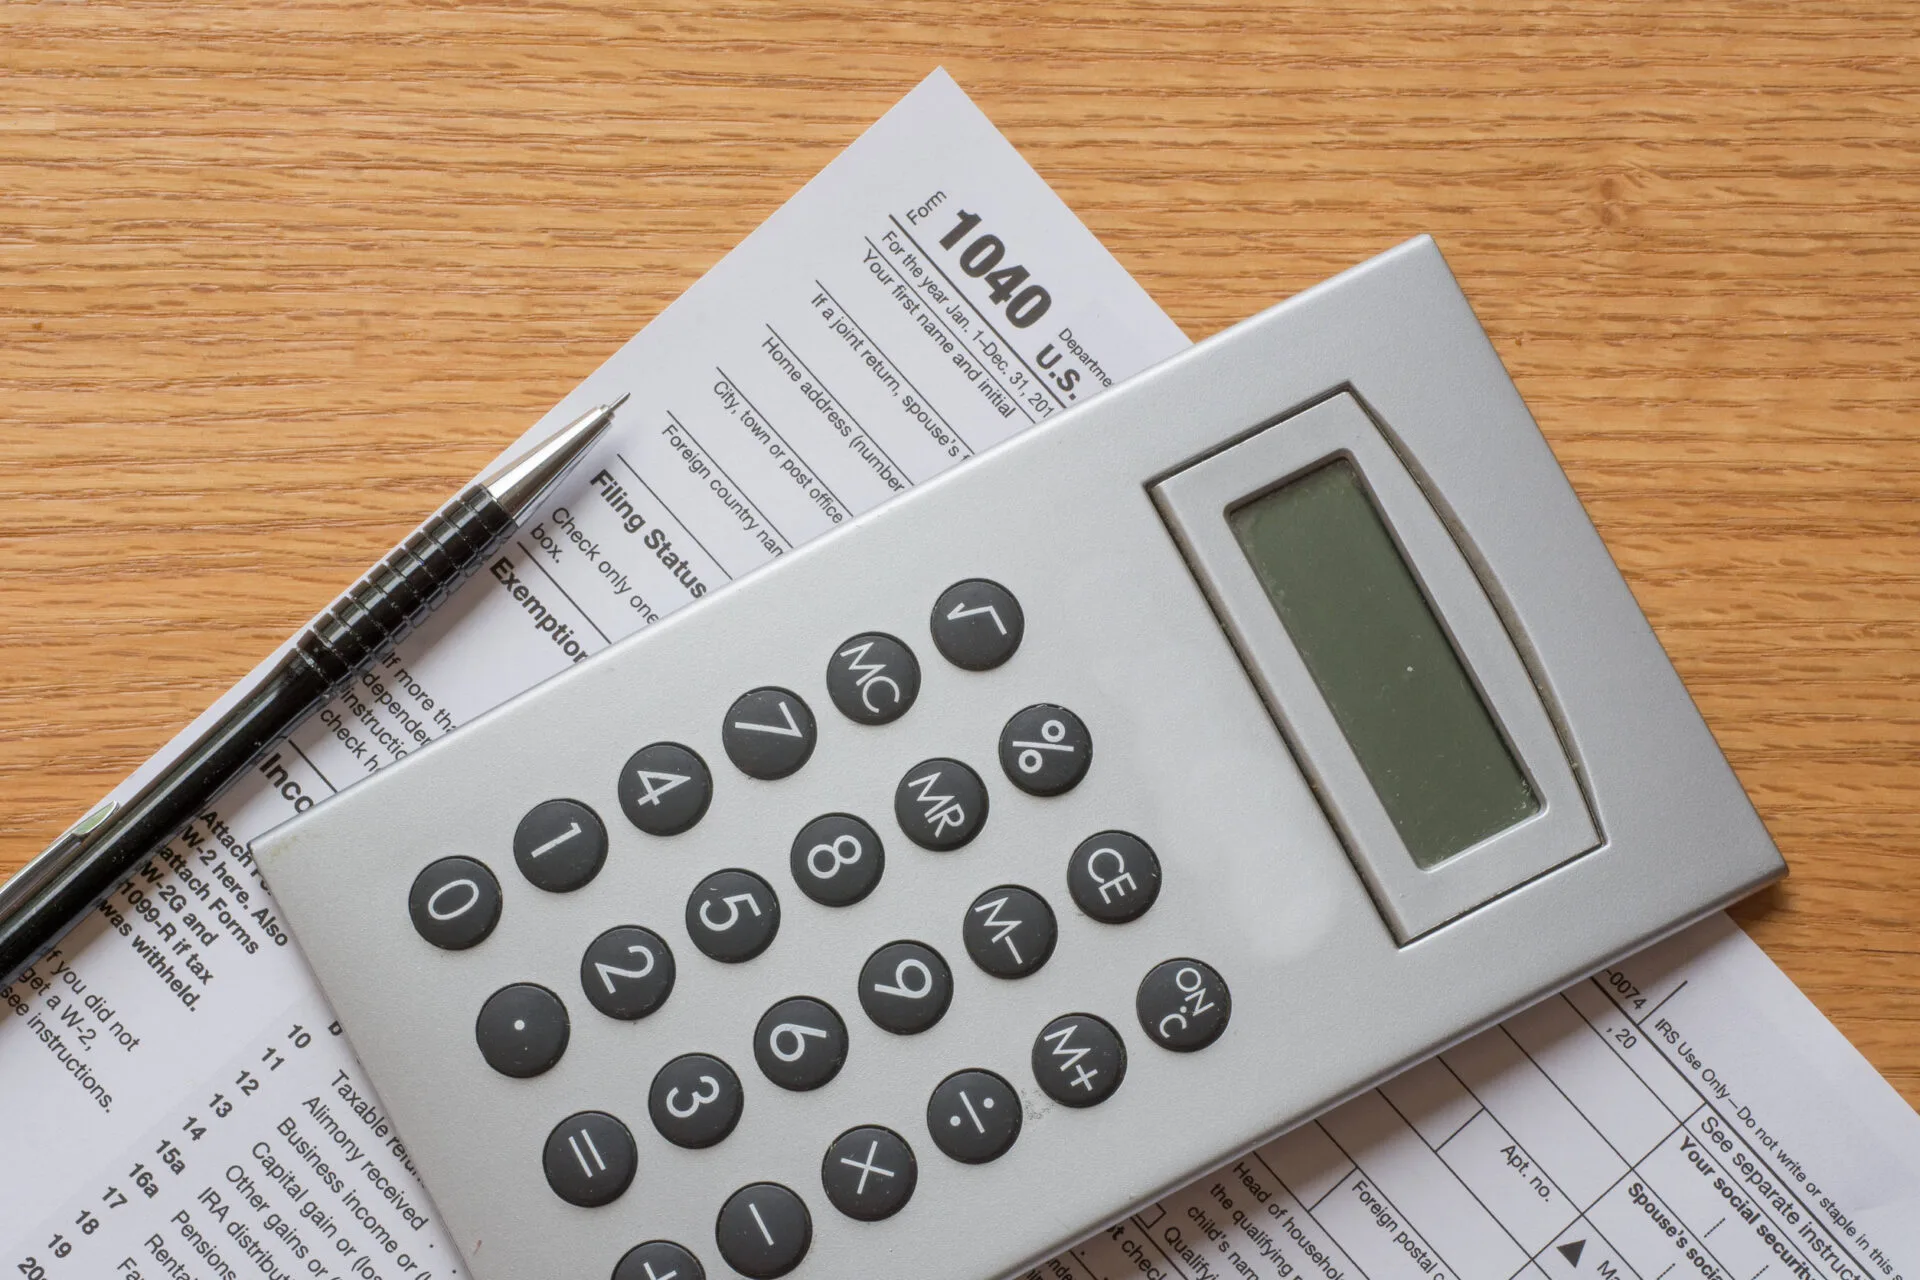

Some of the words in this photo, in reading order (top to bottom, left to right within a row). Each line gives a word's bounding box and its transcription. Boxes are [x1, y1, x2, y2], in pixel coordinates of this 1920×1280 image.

[905, 190, 947, 226] Form
[938, 209, 1052, 329] 1040
[811, 293, 829, 308] If
[821, 308, 835, 321] a
[828, 316, 865, 352] joint
[860, 349, 900, 397] return,
[863, 248, 895, 286] Your
[891, 284, 921, 316] first
[916, 313, 954, 354] name
[952, 353, 983, 382] and
[977, 378, 1017, 419] initial
[881, 230, 906, 256] For
[902, 253, 924, 278] the
[917, 275, 950, 305] year
[945, 304, 970, 333] Jan.
[1009, 371, 1029, 397] 31,
[1035, 343, 1081, 401] U.S.
[1058, 327, 1114, 388] Departme
[761, 336, 802, 382] Home
[800, 382, 852, 438] address
[848, 434, 905, 492] (number
[661, 424, 711, 480] Foreign
[709, 479, 760, 531] country
[713, 381, 740, 415] City,
[740, 409, 771, 445] town
[769, 444, 786, 459] or
[779, 458, 813, 489] post
[809, 488, 843, 524] office
[530, 522, 563, 564] box.
[589, 468, 647, 534] Filing
[643, 528, 707, 599] Status
[552, 507, 601, 562] Check
[597, 560, 632, 595] only
[629, 595, 660, 625] one
[394, 668, 435, 711] more
[841, 642, 899, 713] MC
[320, 709, 368, 760] check
[735, 702, 802, 737] 7
[1013, 720, 1074, 773] %
[637, 771, 691, 805] 4
[908, 772, 964, 837] MR
[199, 811, 256, 868] Attach
[532, 823, 581, 857] 1
[807, 835, 862, 879] 8
[140, 860, 187, 914] W-2G
[182, 912, 220, 947] and
[156, 847, 211, 902] attach
[208, 896, 259, 955] Forms
[181, 824, 218, 867] W-2
[211, 861, 250, 910] here.
[250, 907, 288, 947] Also
[1088, 848, 1136, 904] CE
[121, 879, 177, 943] 1099-R
[171, 937, 193, 956] if
[185, 952, 214, 986] tax
[700, 893, 761, 931] 5
[96, 899, 133, 937] was
[131, 934, 201, 1013] withheld.
[595, 946, 654, 993] 2
[17, 963, 52, 997] get
[46, 995, 62, 1011] a
[60, 1003, 97, 1052] W-2,
[50, 960, 87, 995] you
[84, 994, 116, 1024] did
[108, 1021, 140, 1052] not
[287, 1024, 312, 1049] 10
[2, 986, 30, 1017] see
[27, 1012, 113, 1114] instructions.
[261, 1047, 285, 1072] 11
[209, 1093, 233, 1119] 13
[235, 1070, 260, 1097] 12
[331, 1068, 389, 1138] Taxable
[667, 1076, 719, 1117] 3
[155, 1139, 186, 1176] 15a
[182, 1116, 208, 1142] 14
[1654, 1017, 1680, 1045] IRS
[1677, 1041, 1702, 1071] Use
[1754, 1127, 1779, 1152] not
[1776, 1149, 1807, 1183] write
[1805, 1182, 1822, 1197] or
[1819, 1197, 1857, 1237] staple
[1855, 1233, 1870, 1251] in
[1868, 1248, 1894, 1275] this
[128, 1163, 159, 1199] 16a
[276, 1116, 345, 1194] Business
[341, 1188, 398, 1254] income
[396, 1253, 418, 1272] or
[301, 1096, 365, 1162] Alimony
[360, 1160, 429, 1232] received
[1232, 1161, 1273, 1204] Head
[1267, 1203, 1289, 1220] of
[1499, 1145, 1530, 1178] Apt.
[1529, 1175, 1551, 1203] no.
[1679, 1135, 1716, 1176] Your
[1713, 1177, 1761, 1225] social
[1700, 1116, 1734, 1153] See
[1732, 1152, 1800, 1225] separate
[75, 1210, 100, 1236] 18
[102, 1186, 128, 1209] 17
[197, 1186, 230, 1224] IRA
[225, 1165, 271, 1212] Other
[263, 1213, 309, 1259] gains
[307, 1258, 329, 1280] or
[251, 1141, 309, 1202] Capital
[299, 1201, 338, 1239] gain
[335, 1238, 357, 1257] or
[1351, 1180, 1398, 1233] Foreign
[1392, 1230, 1439, 1274] postal
[47, 1233, 72, 1259] 19
[144, 1233, 190, 1280] Renta
[170, 1209, 237, 1280] Pensions
[1209, 1183, 1234, 1210] the
[1232, 1210, 1294, 1280] qualifying
[17, 1256, 45, 1280] 20
